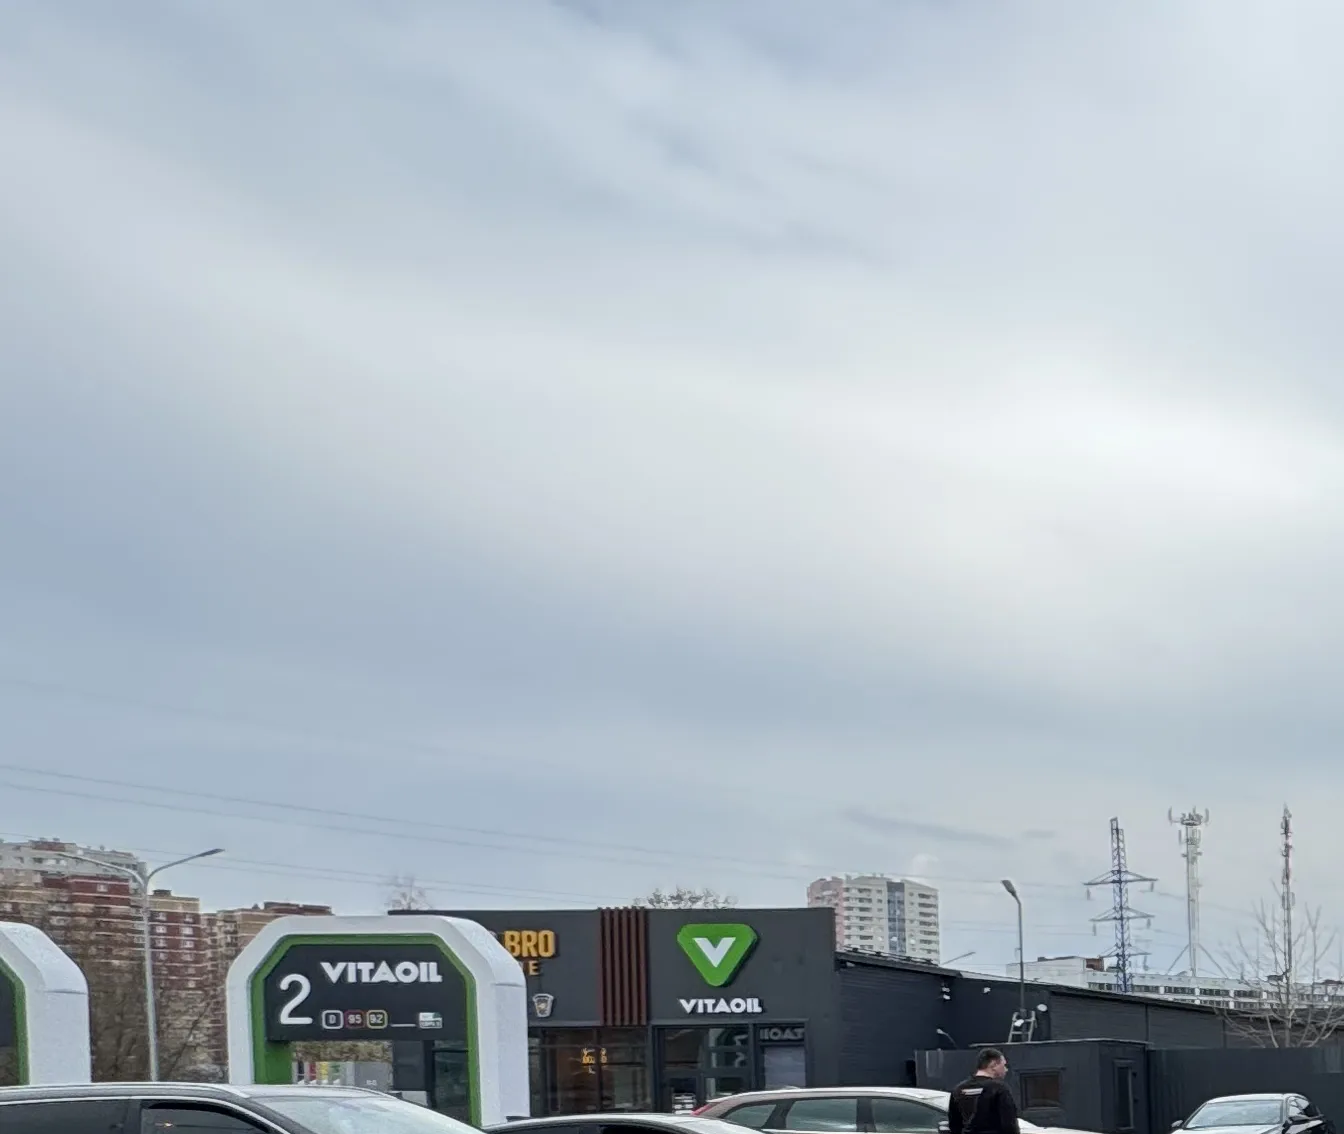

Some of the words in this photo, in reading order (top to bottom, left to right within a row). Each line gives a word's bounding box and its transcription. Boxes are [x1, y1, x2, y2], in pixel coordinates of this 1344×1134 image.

[503, 930, 555, 957] BRO
[320, 961, 443, 984] VITAOIL
[279, 973, 313, 1025] 2
[679, 998, 762, 1013] VITAOIL
[369, 1014, 383, 1024] 92
